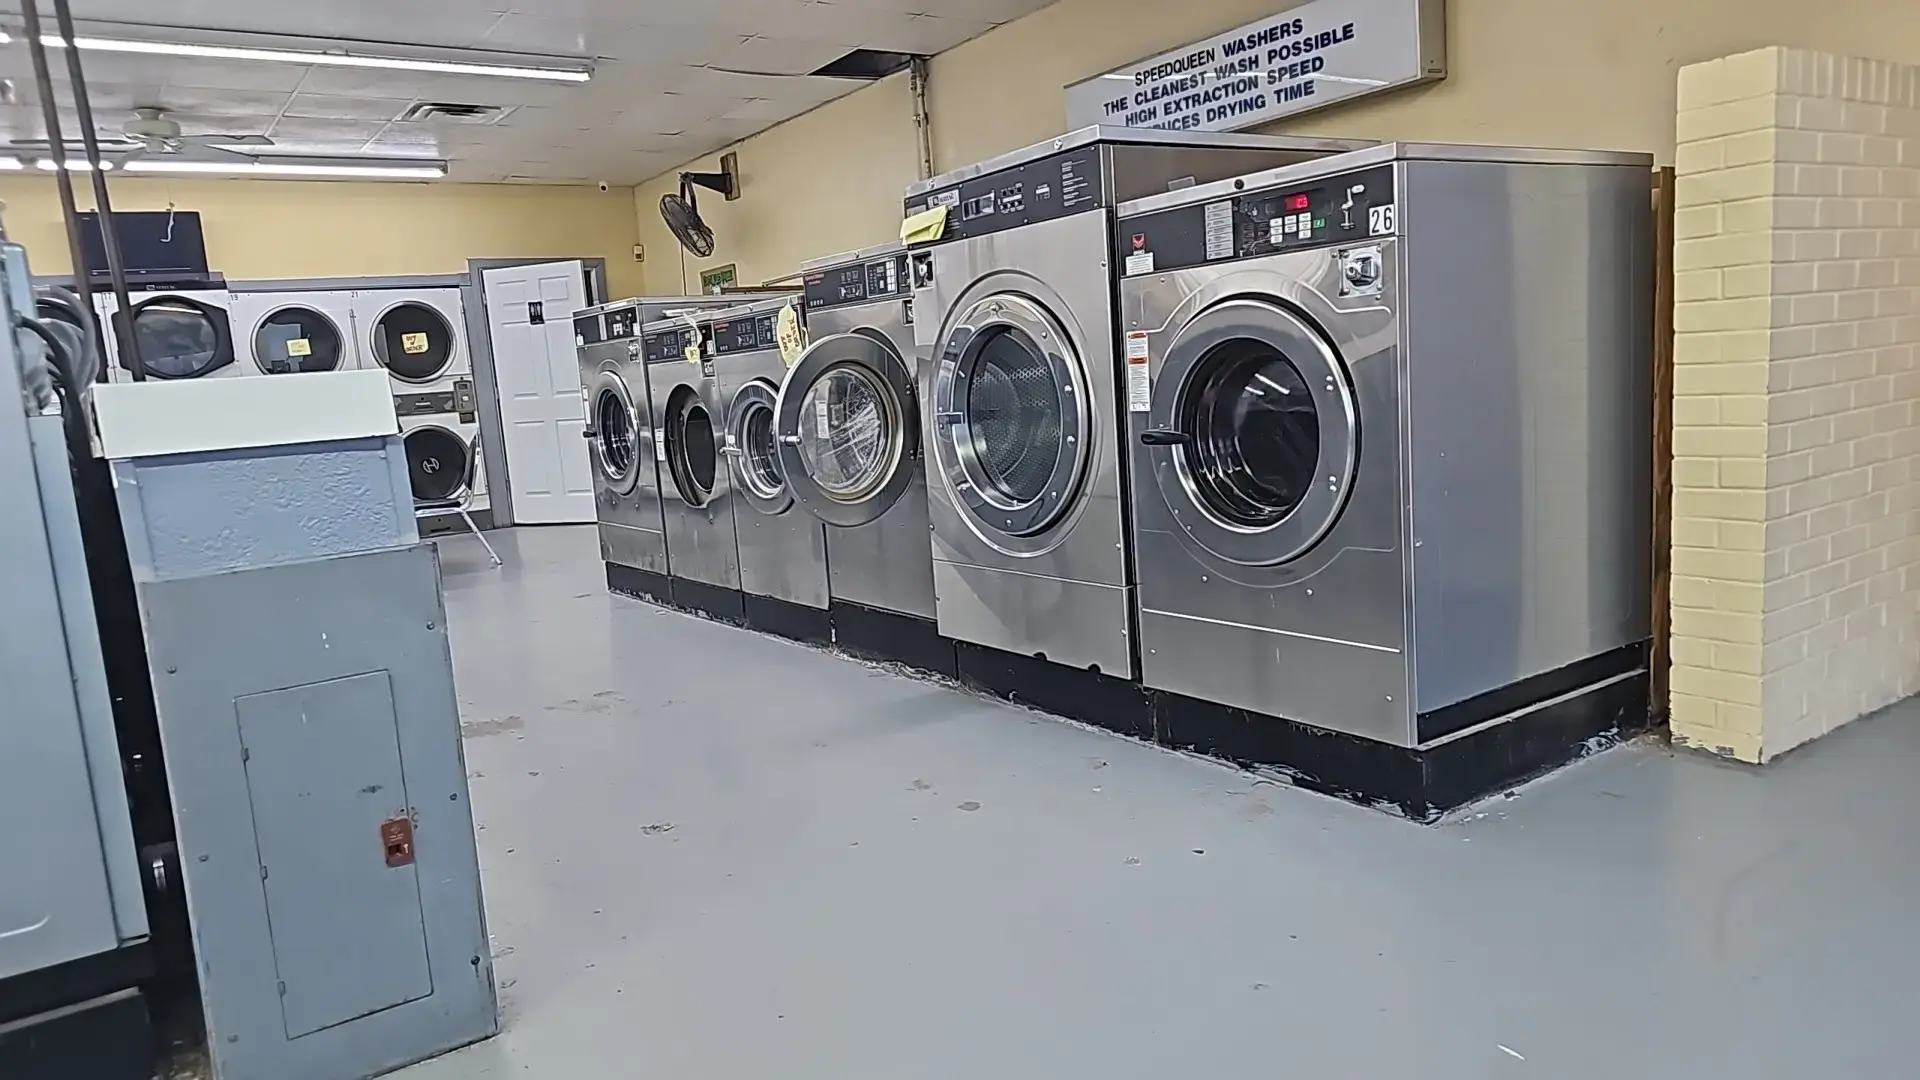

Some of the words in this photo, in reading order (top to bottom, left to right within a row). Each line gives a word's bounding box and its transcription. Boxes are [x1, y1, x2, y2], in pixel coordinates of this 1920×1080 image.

[1103, 96, 1129, 117] THE
[1134, 70, 1208, 107] CLEANEST
[1214, 55, 1260, 82] WASH
[1267, 23, 1355, 65] POSSIBLE
[1134, 48, 1216, 87] SPEEDQUEEN
[1222, 18, 1304, 58] WASHERS
[1125, 107, 1158, 127] HIGH
[1163, 75, 1260, 116] EXTRACTION
[1267, 56, 1325, 86] SPEED
[1147, 112, 1201, 131] UCES
[1206, 95, 1267, 123] DRYING
[1273, 80, 1316, 104] TIME
[1371, 207, 1393, 233] 26
